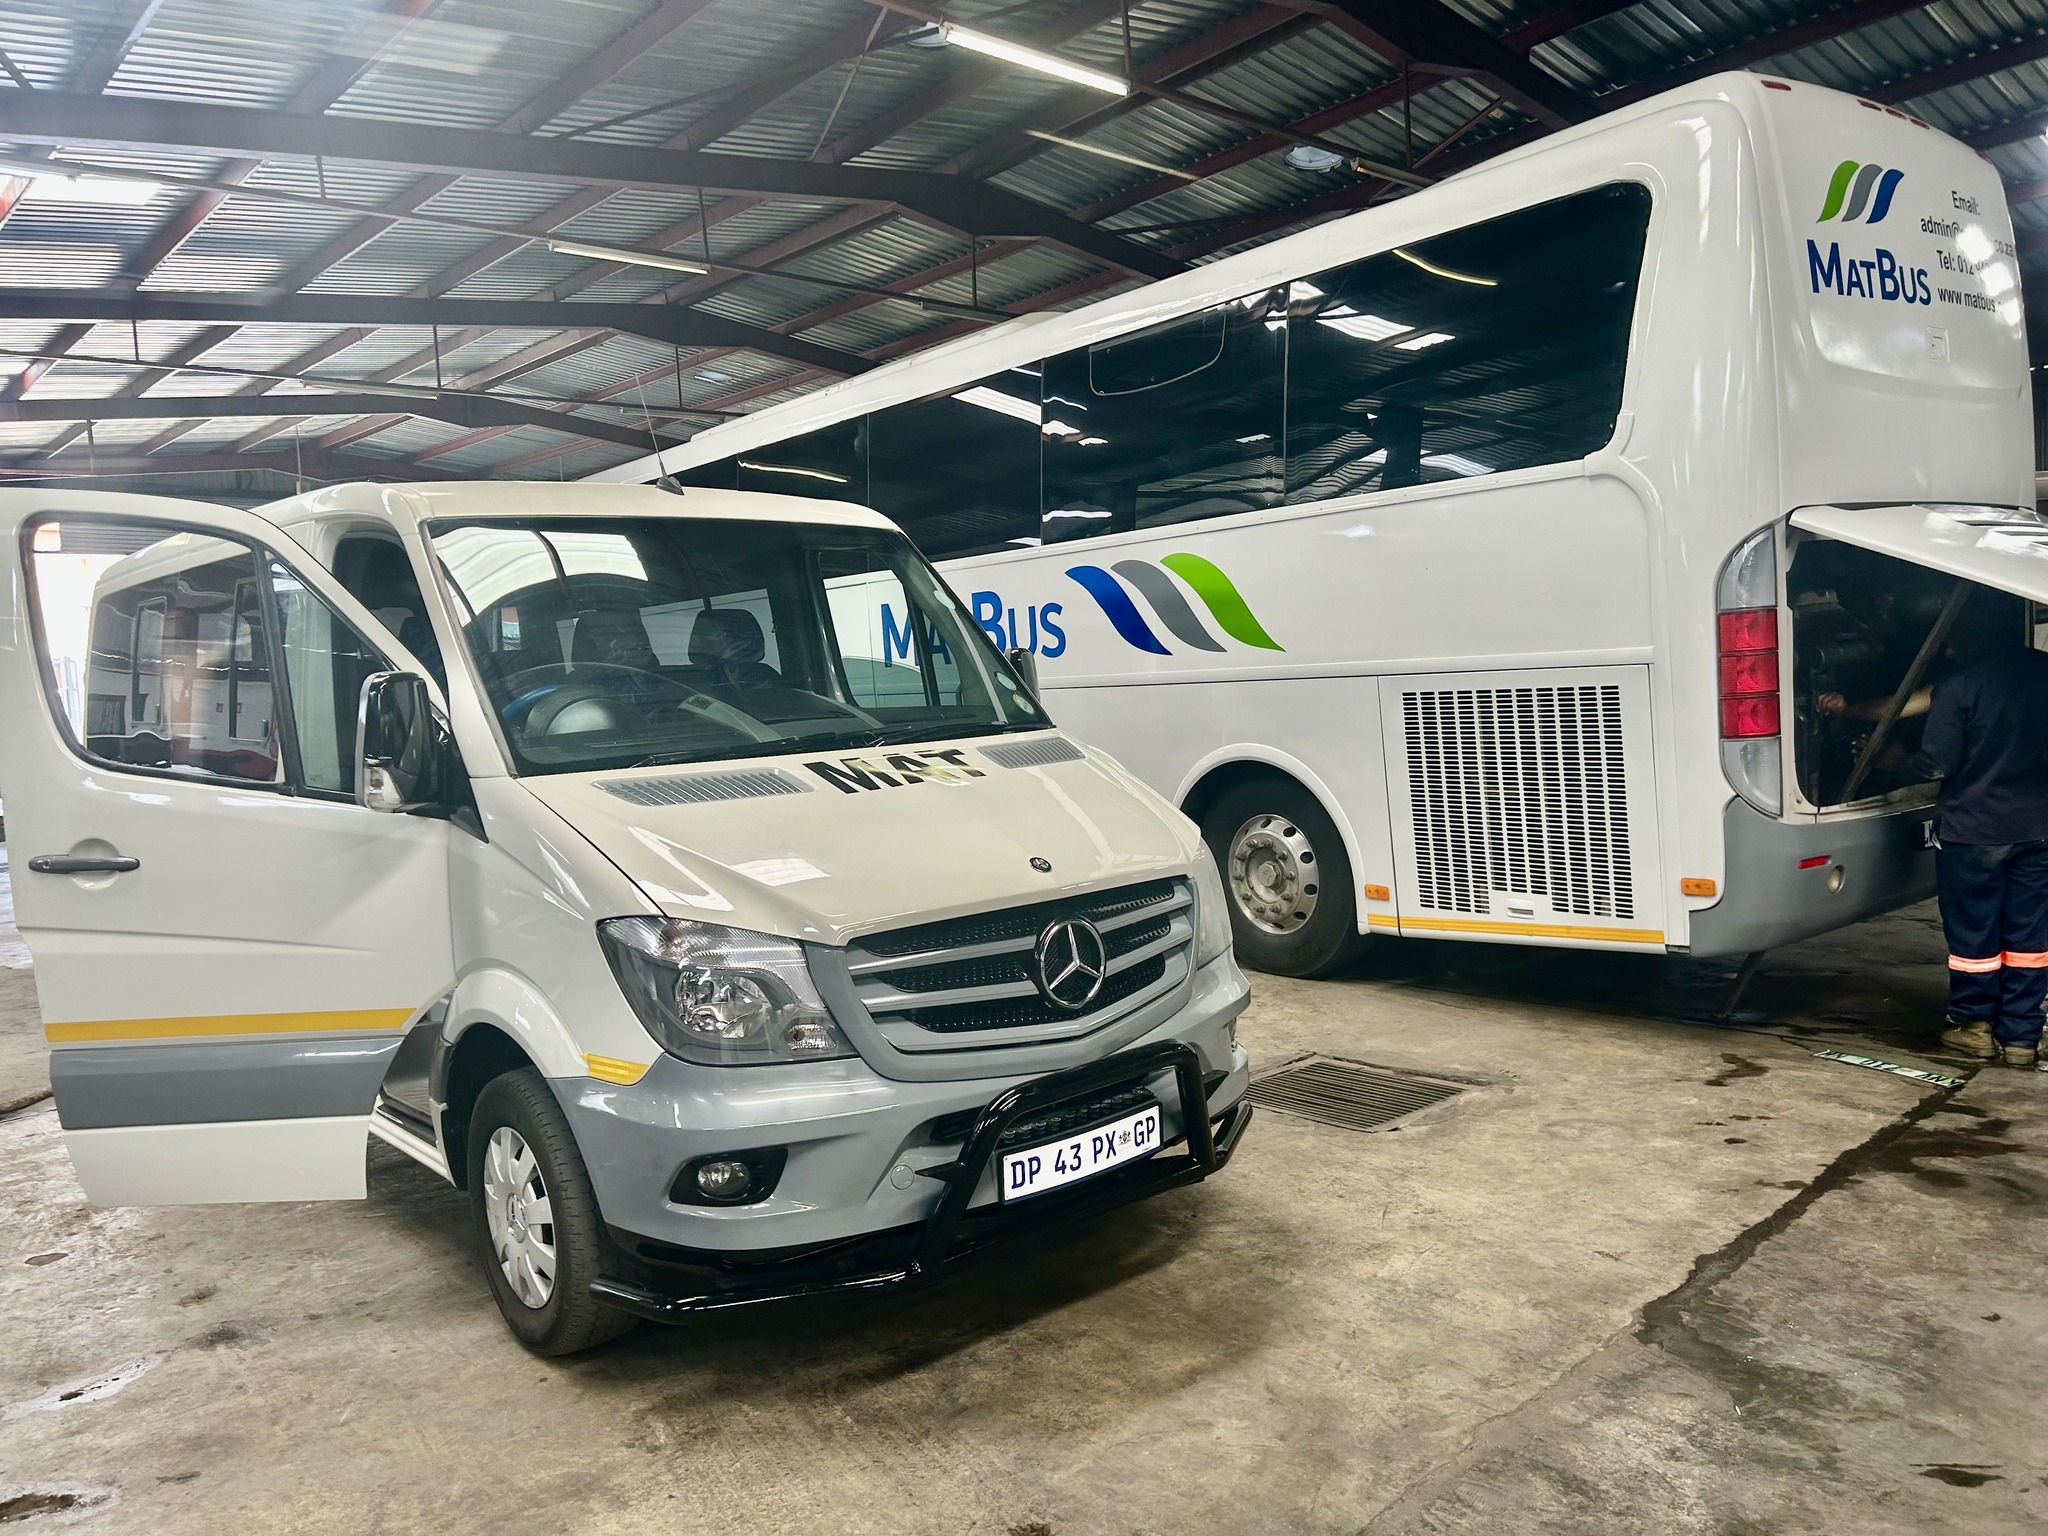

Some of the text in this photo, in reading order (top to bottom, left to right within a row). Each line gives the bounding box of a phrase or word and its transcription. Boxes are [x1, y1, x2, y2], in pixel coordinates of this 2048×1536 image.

[1951, 190, 1981, 217] Email:
[1806, 239, 1931, 306] MATBUS
[1936, 249, 1956, 271] Tel:
[880, 590, 1067, 668] MABUS
[802, 749, 987, 795] MAT
[1010, 1115, 1156, 1190] DP 43 PX GP
